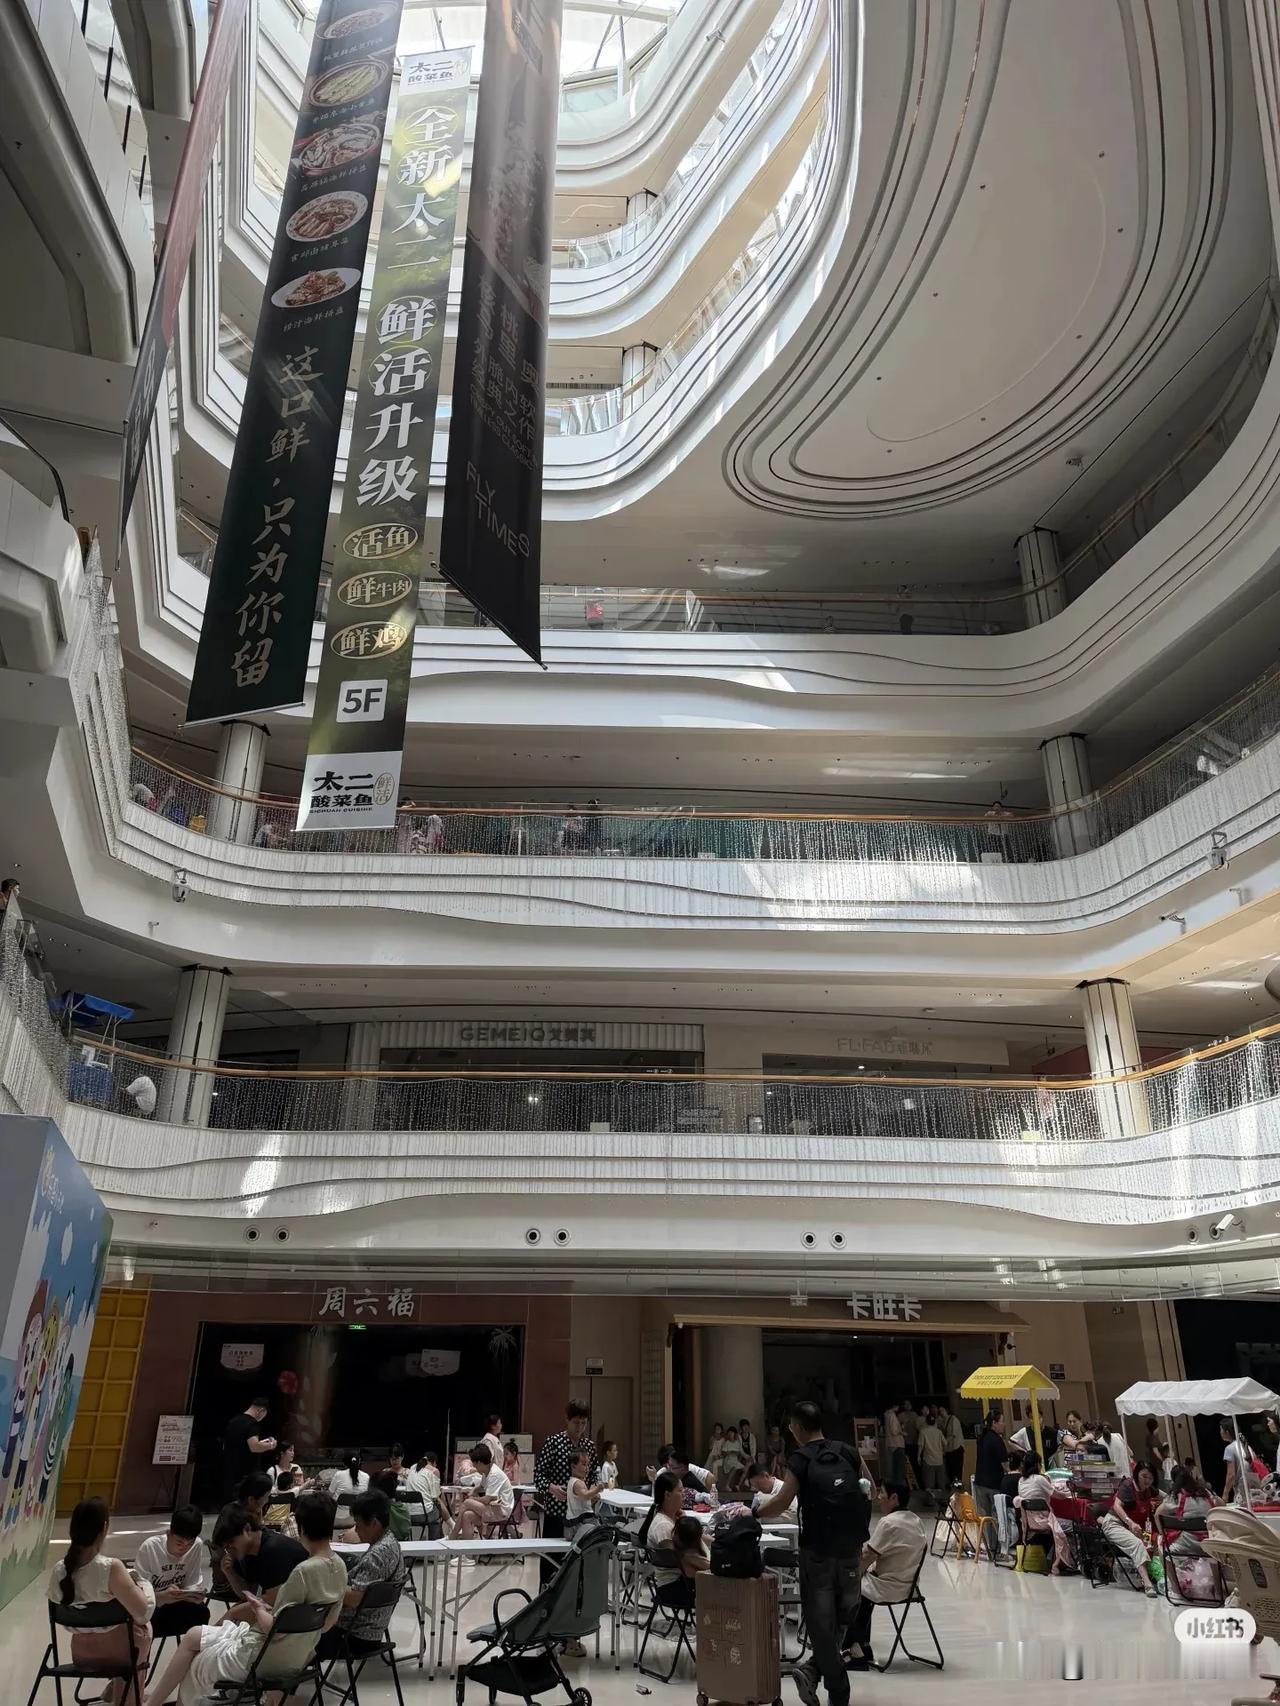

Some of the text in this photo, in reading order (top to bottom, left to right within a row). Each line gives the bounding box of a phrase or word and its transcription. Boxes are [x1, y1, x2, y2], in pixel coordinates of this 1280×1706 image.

[408, 60, 453, 75] 太二
[387, 107, 456, 270] 全新太二
[356, 298, 436, 507] 鲜活升级
[466, 460, 496, 506] FLY
[474, 493, 530, 558] TIMES
[351, 526, 409, 557] 活鱼
[346, 574, 410, 605] 鲜牛肉
[339, 624, 401, 656] 鲜鸡
[342, 687, 383, 714] 5F
[312, 770, 374, 792] 太二
[310, 793, 374, 809] 酸菜鱼
[461, 1027, 546, 1042] GEMEIQ
[318, 1286, 415, 1318] 周六福
[846, 1291, 922, 1321] 卡旺卡
